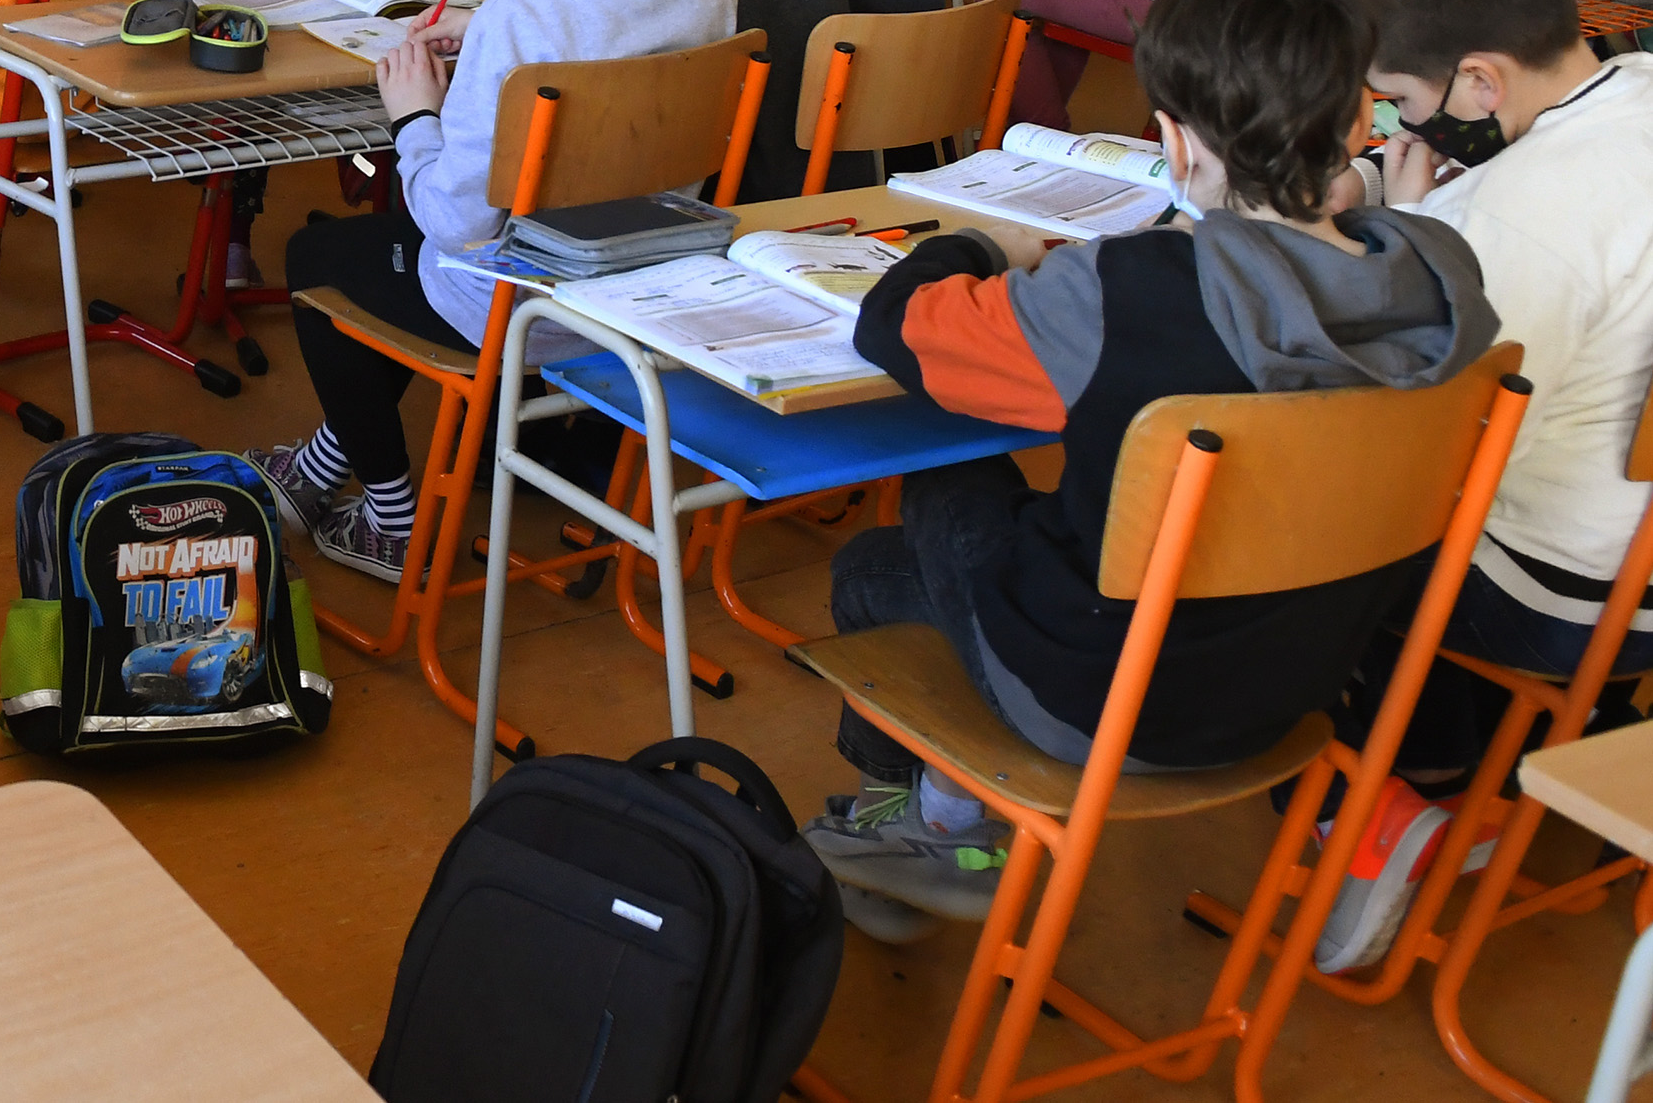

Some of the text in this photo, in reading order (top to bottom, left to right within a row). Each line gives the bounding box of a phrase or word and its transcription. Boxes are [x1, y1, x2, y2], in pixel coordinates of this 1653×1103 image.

[158, 506, 183, 524] HOT
[118, 535, 255, 577] NOT AFRAID
[121, 573, 231, 628] TO FAIL
